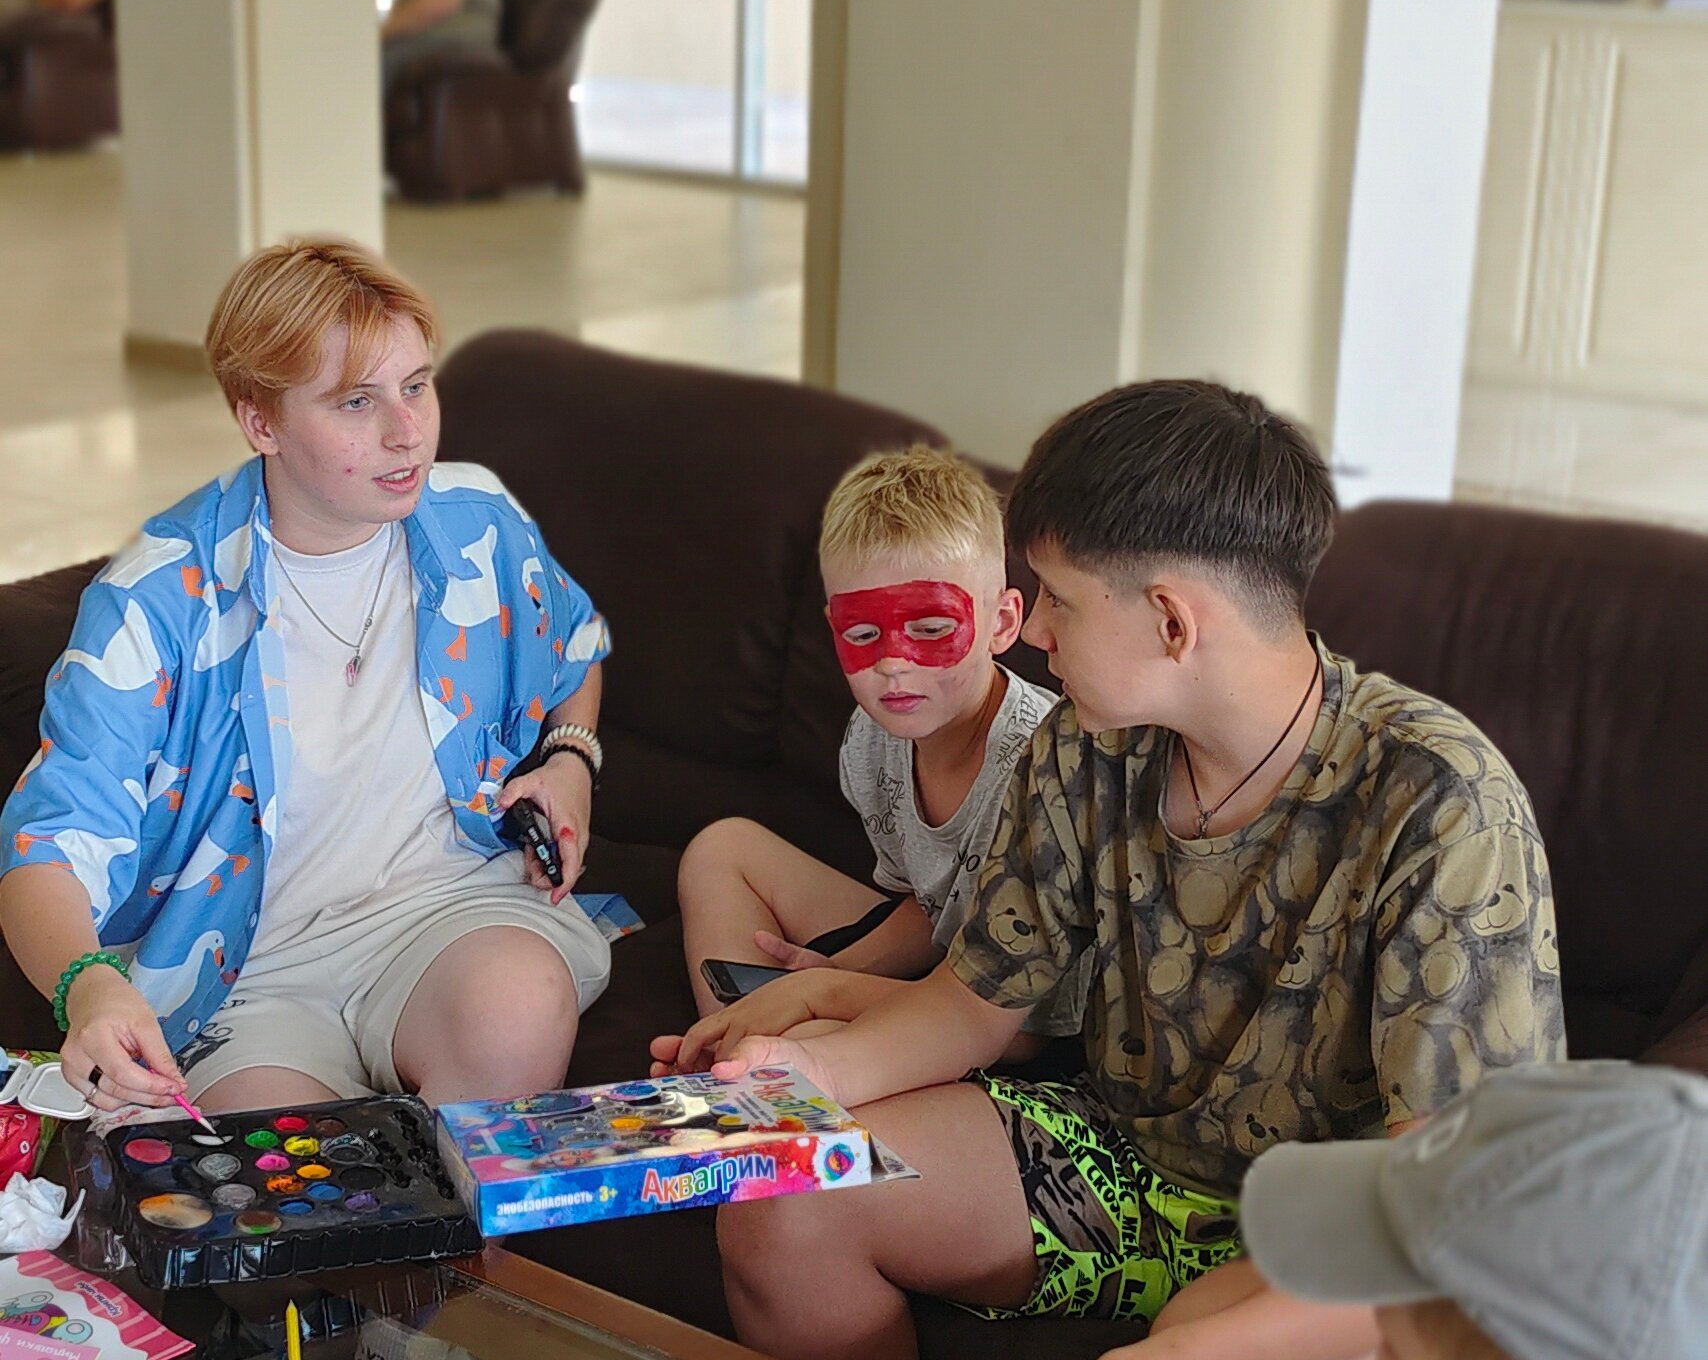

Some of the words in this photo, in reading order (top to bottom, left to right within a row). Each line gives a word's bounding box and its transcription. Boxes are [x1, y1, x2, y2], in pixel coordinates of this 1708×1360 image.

[496, 1190, 593, 1216] ЭКОБЕЗОПАСНОСТЬ
[598, 1185, 619, 1203] 3+
[641, 1153, 778, 1204] Аквагрим
